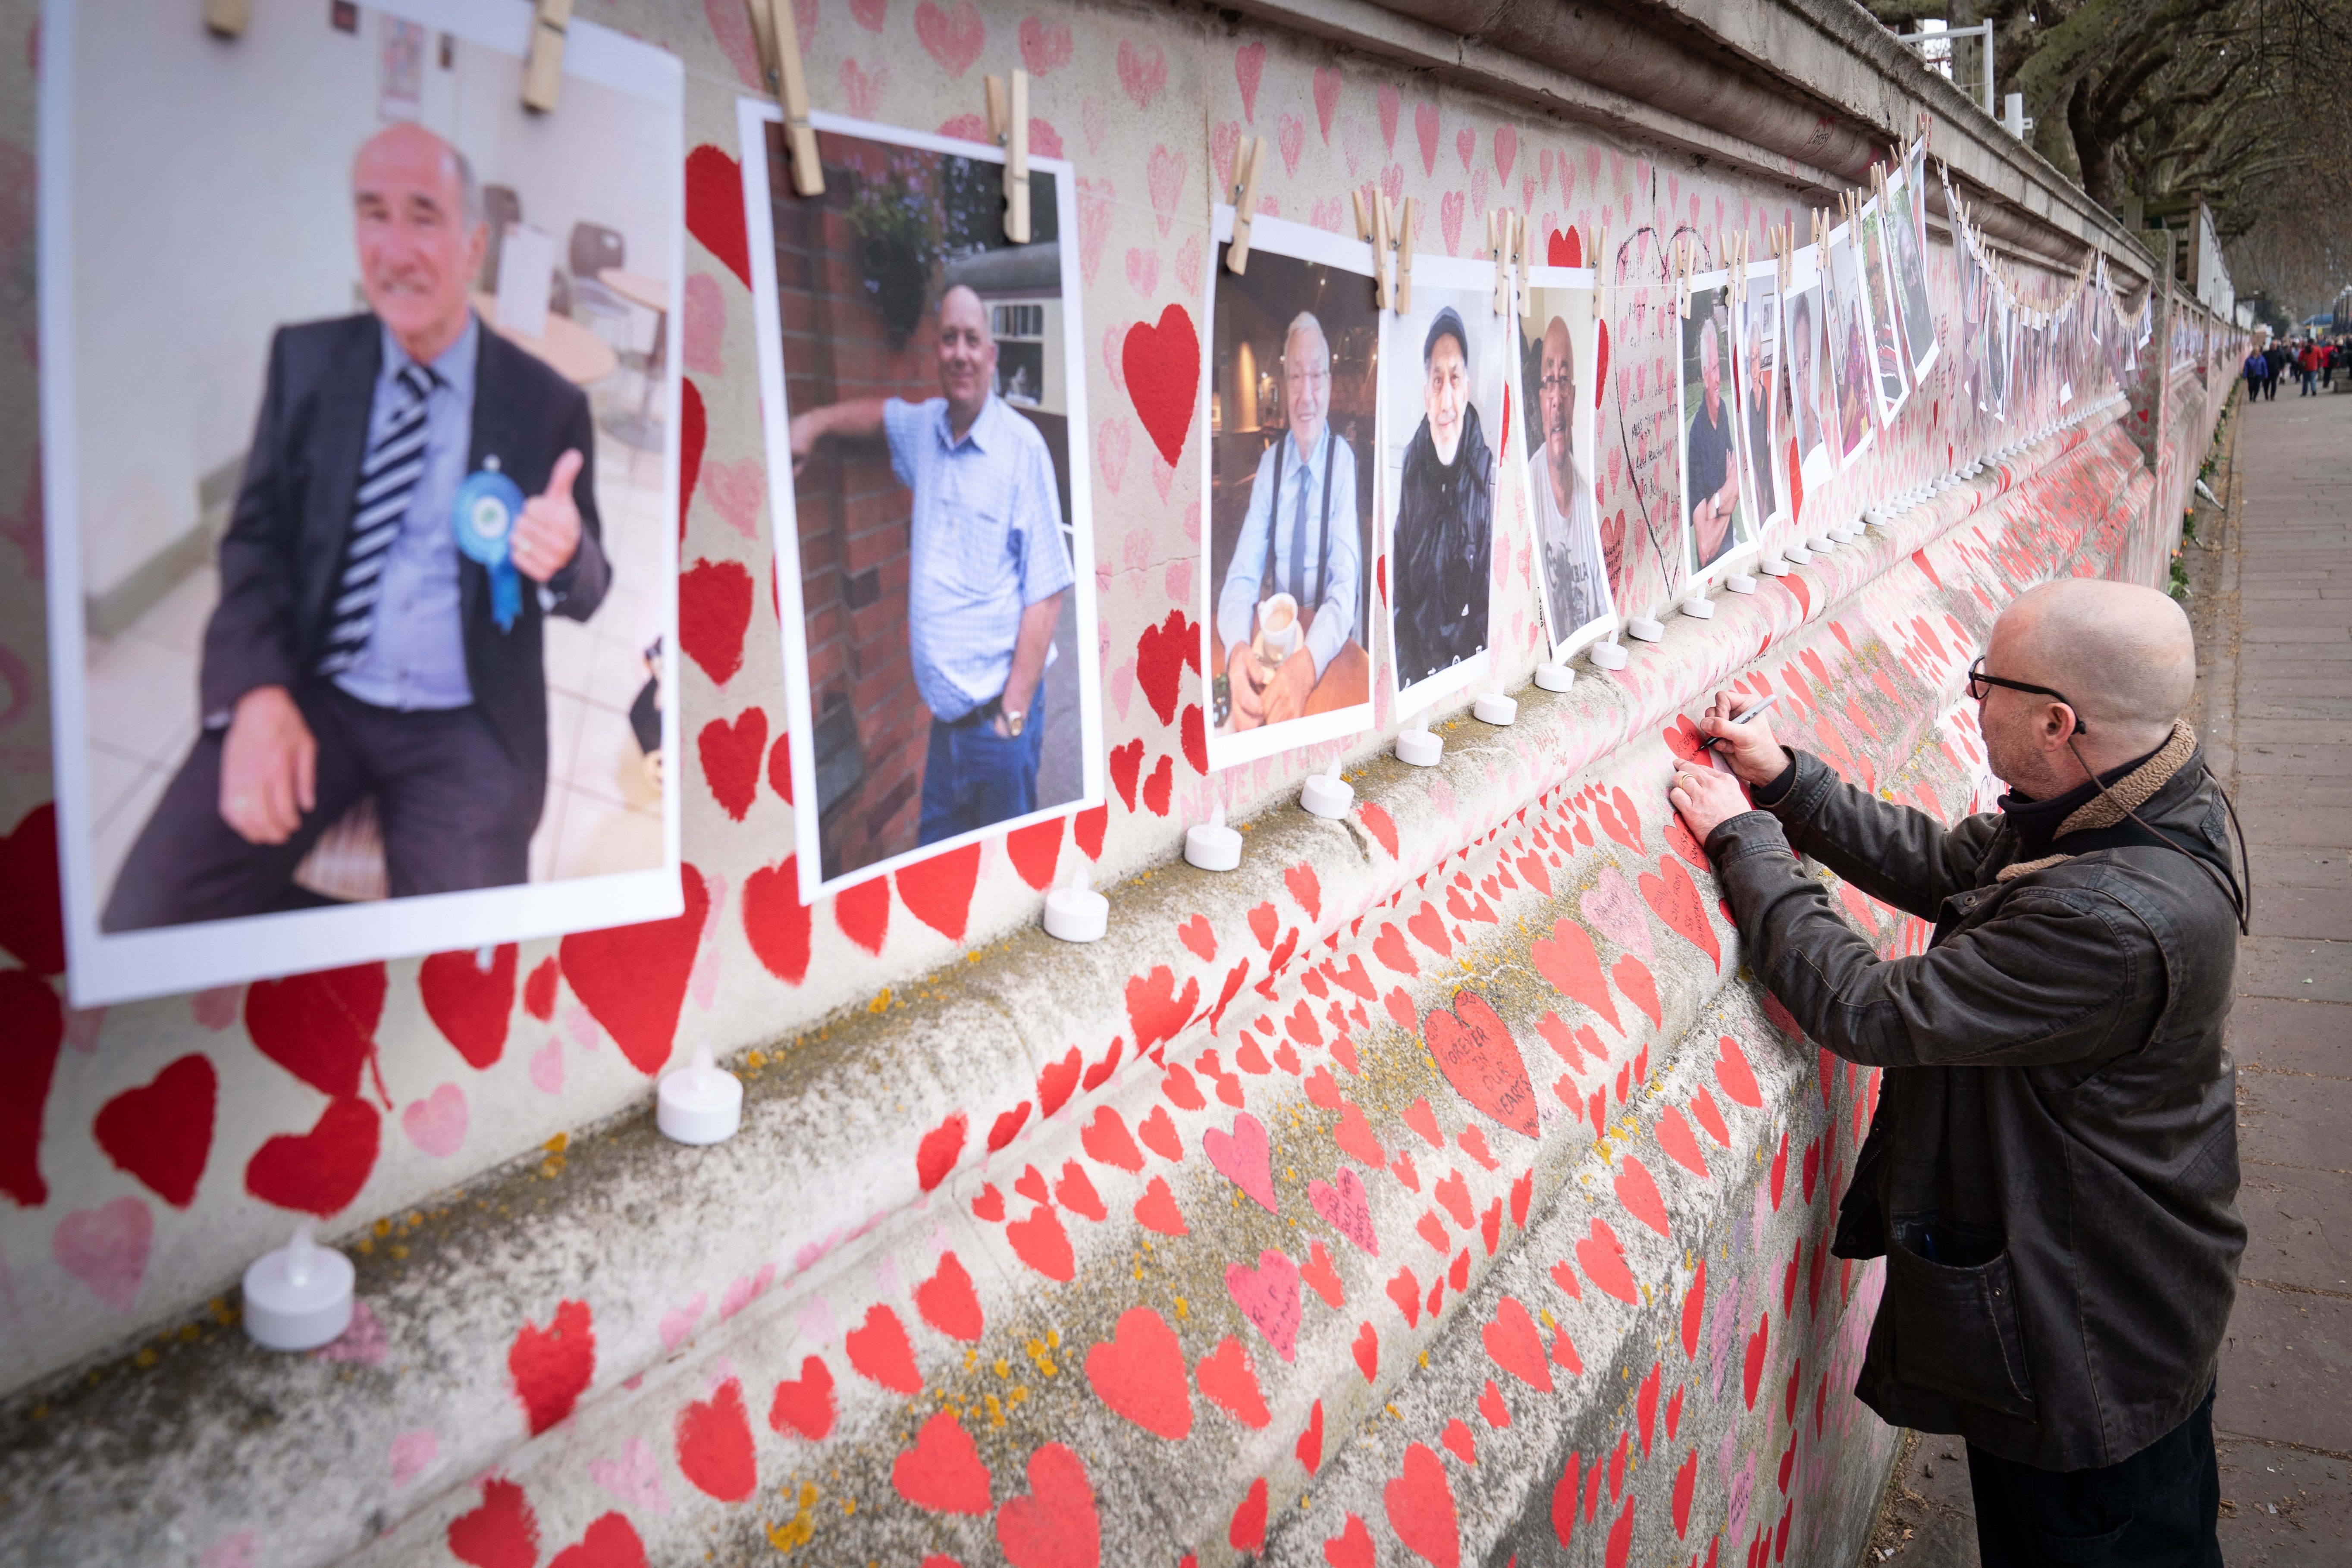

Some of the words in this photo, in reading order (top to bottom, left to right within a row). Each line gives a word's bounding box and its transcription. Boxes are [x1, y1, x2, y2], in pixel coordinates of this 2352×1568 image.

[1440, 1026, 1490, 1066] FOREVER
[1482, 1061, 1510, 1091] OUR
[1493, 1074, 1532, 1116] HEARTS
